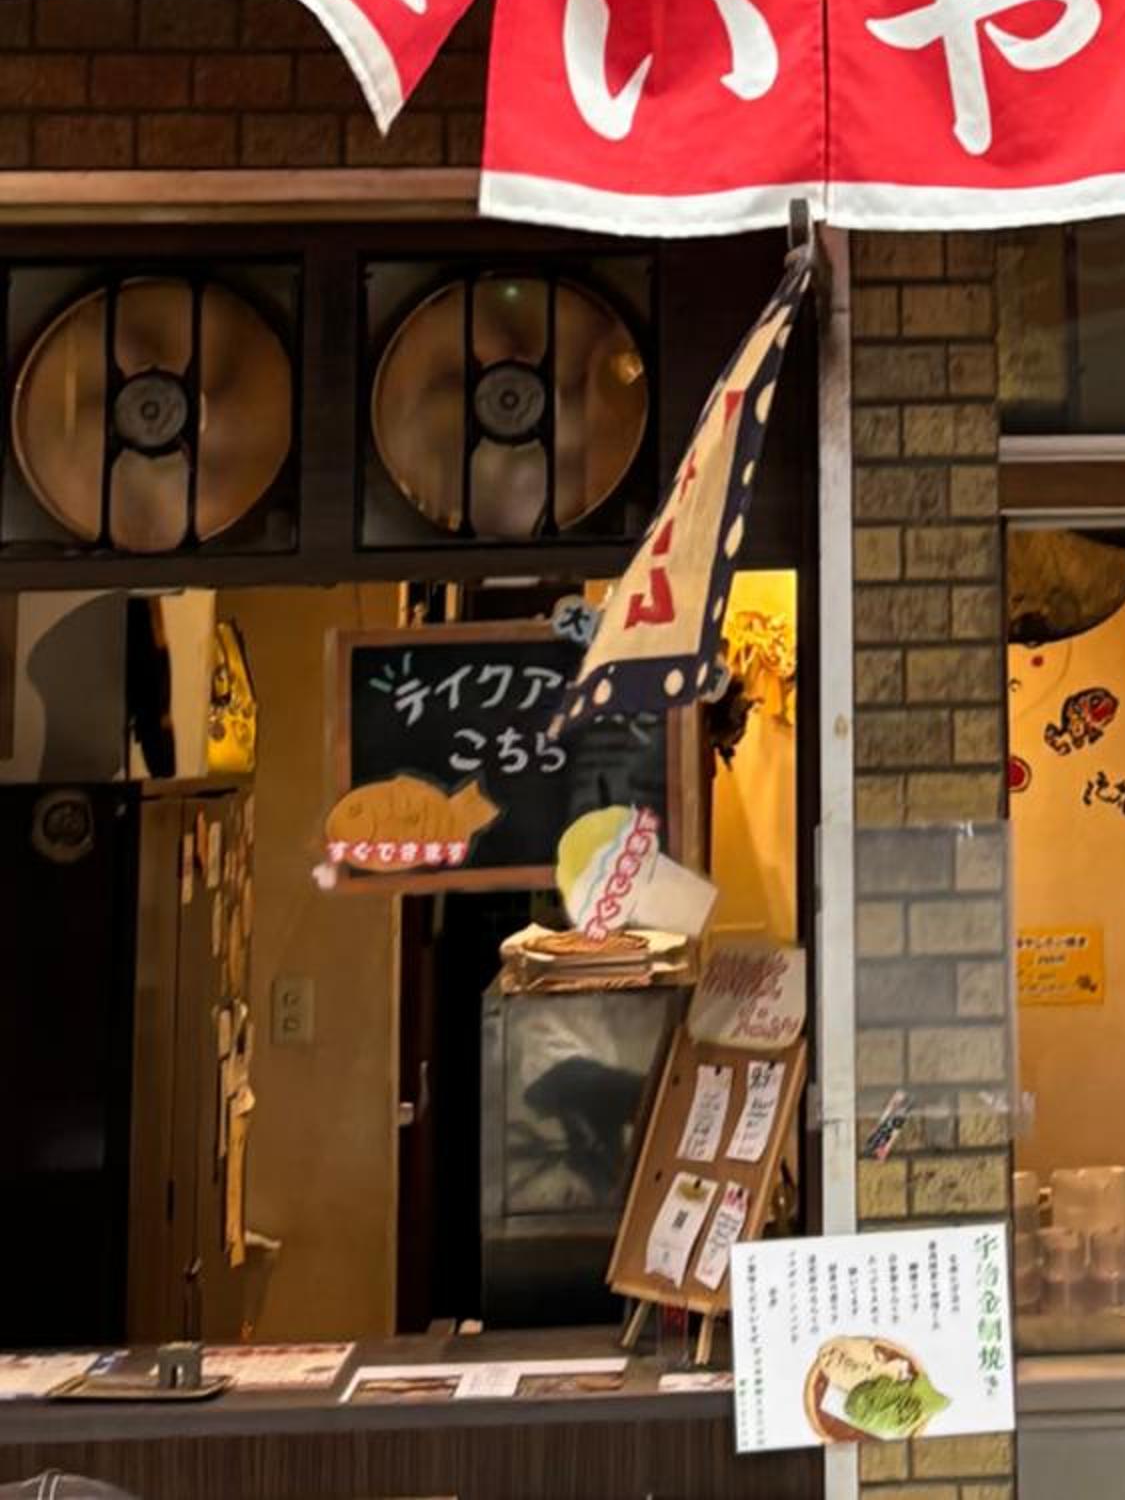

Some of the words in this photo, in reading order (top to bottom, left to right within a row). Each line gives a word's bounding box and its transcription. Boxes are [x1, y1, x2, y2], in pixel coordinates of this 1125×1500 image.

[394, 664, 572, 726] テイクア
[448, 726, 568, 773] こちら
